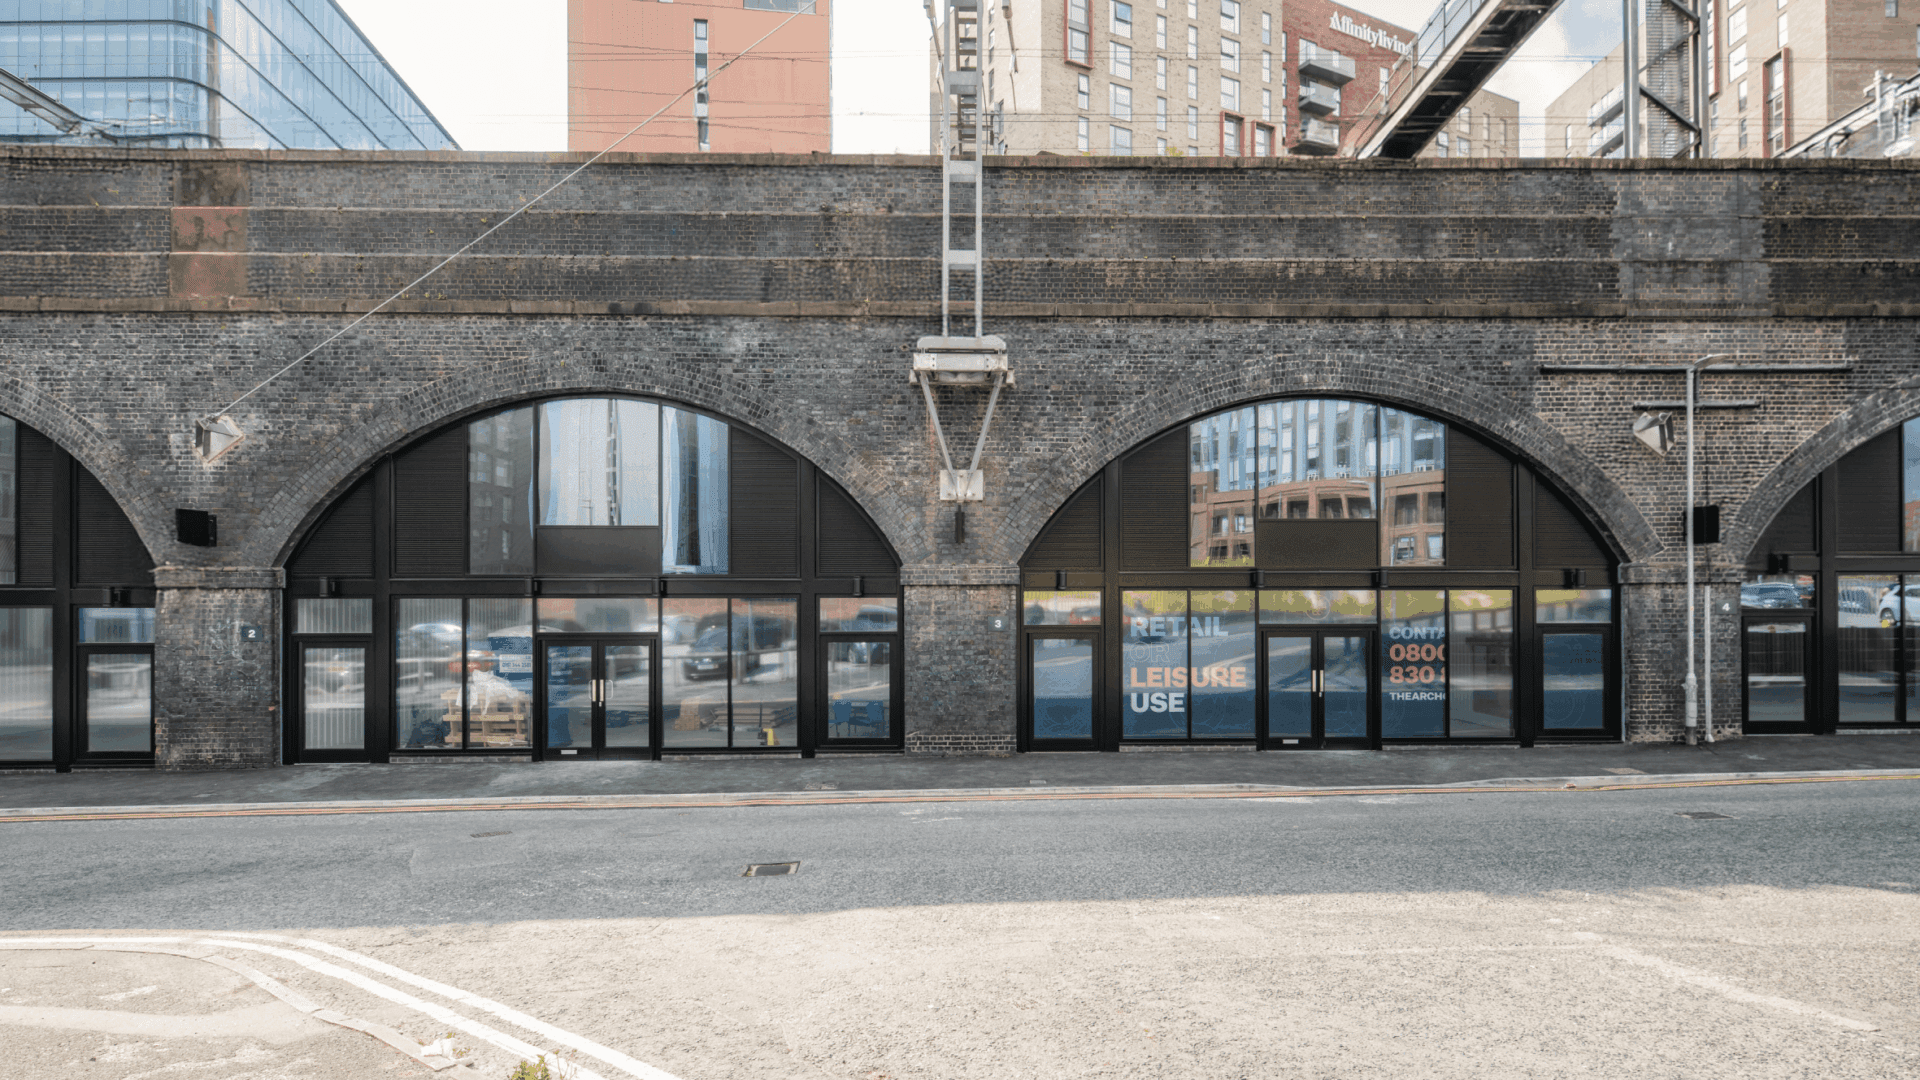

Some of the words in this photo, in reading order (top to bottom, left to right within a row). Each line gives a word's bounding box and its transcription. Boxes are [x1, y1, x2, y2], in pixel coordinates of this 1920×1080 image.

[1722, 603, 1730, 611] 4
[248, 629, 256, 638] 2
[994, 619, 1002, 628] 3
[1130, 616, 1229, 637] RETAIL
[1130, 641, 1170, 663] OR
[1130, 666, 1247, 688] LEISURE
[1389, 665, 1435, 684] 830
[1130, 692, 1185, 713] USE
